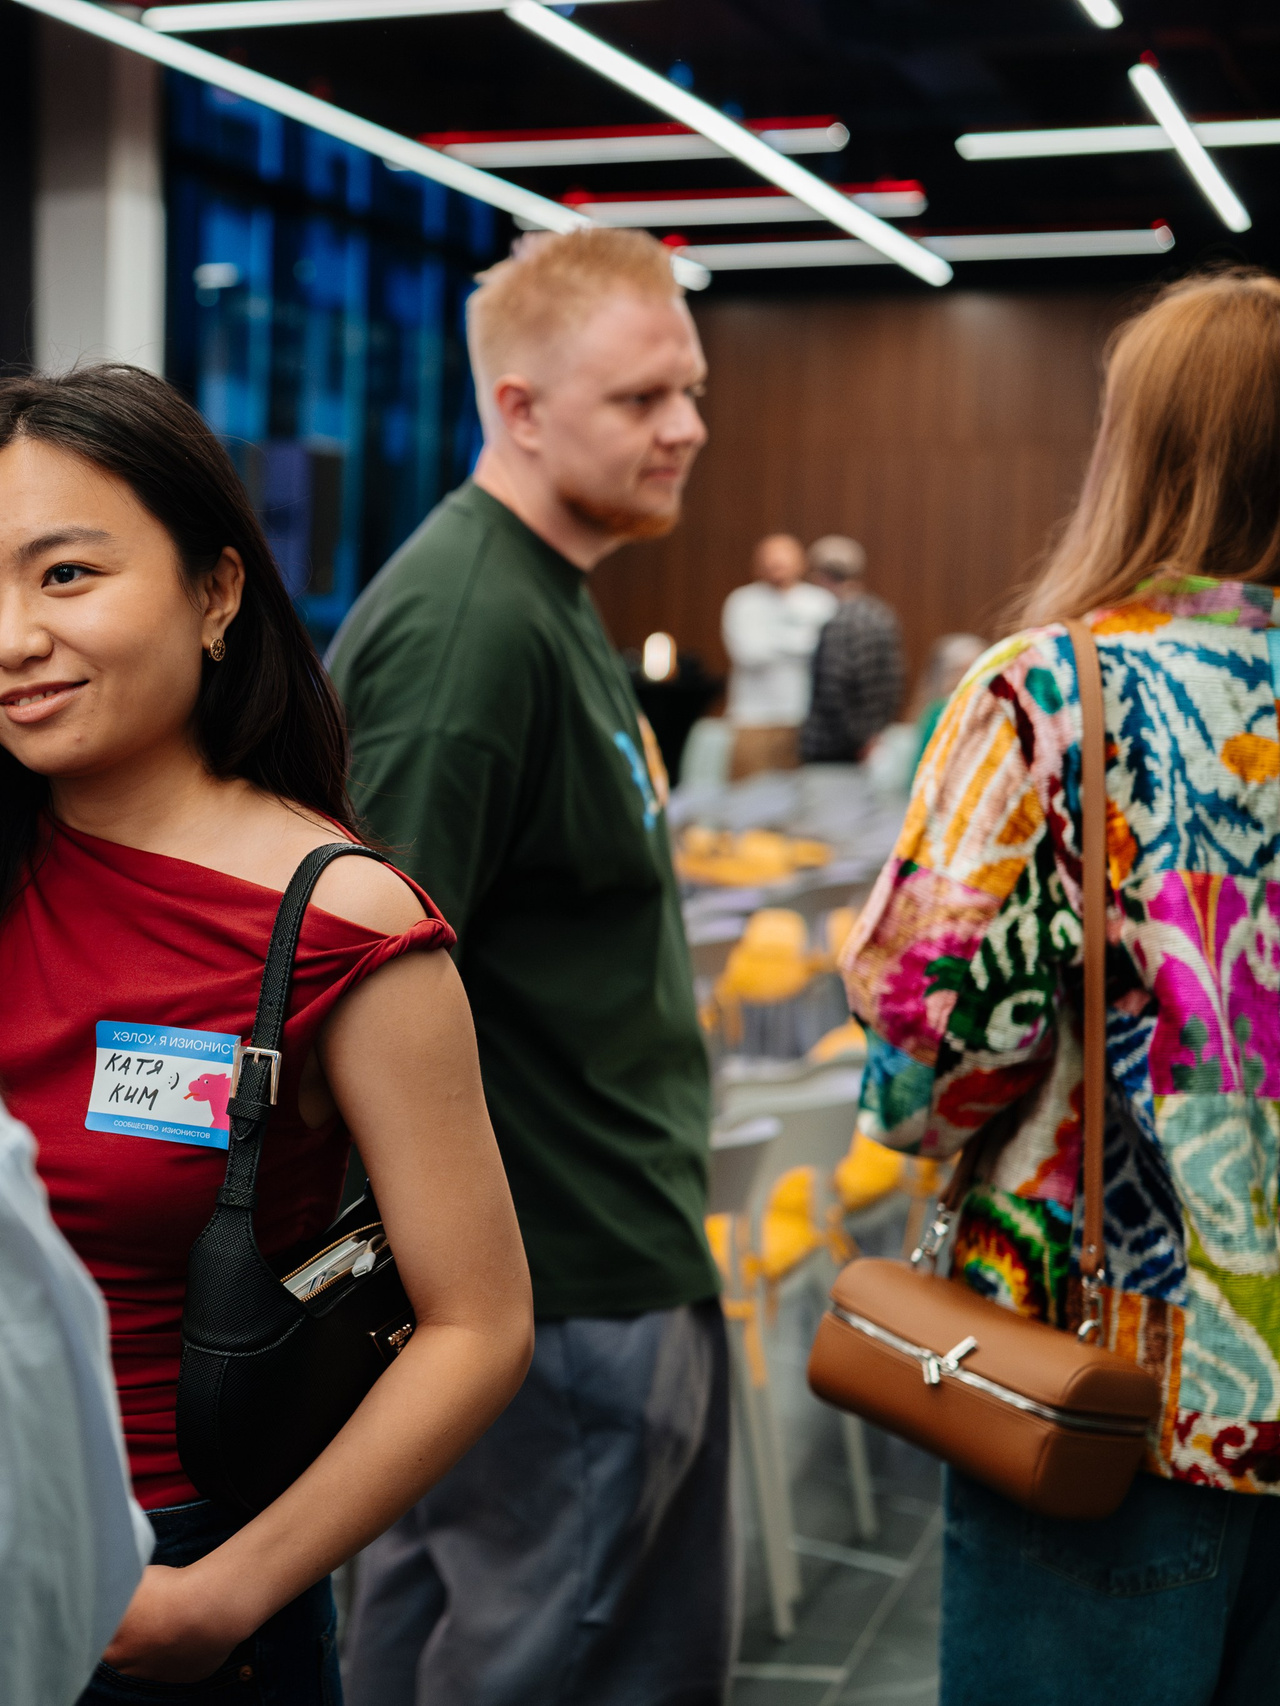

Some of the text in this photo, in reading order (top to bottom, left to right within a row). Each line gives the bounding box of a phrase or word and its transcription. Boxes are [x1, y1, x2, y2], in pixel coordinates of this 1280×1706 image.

[112, 1031, 156, 1046] ХЭЛОУ,
[159, 1036, 167, 1046] Я
[104, 1052, 164, 1076] КАТЯ
[108, 1083, 159, 1111] КИМ
[113, 1119, 211, 1139] СООБЩЕСТВО ИЗИОНИСТОВ
